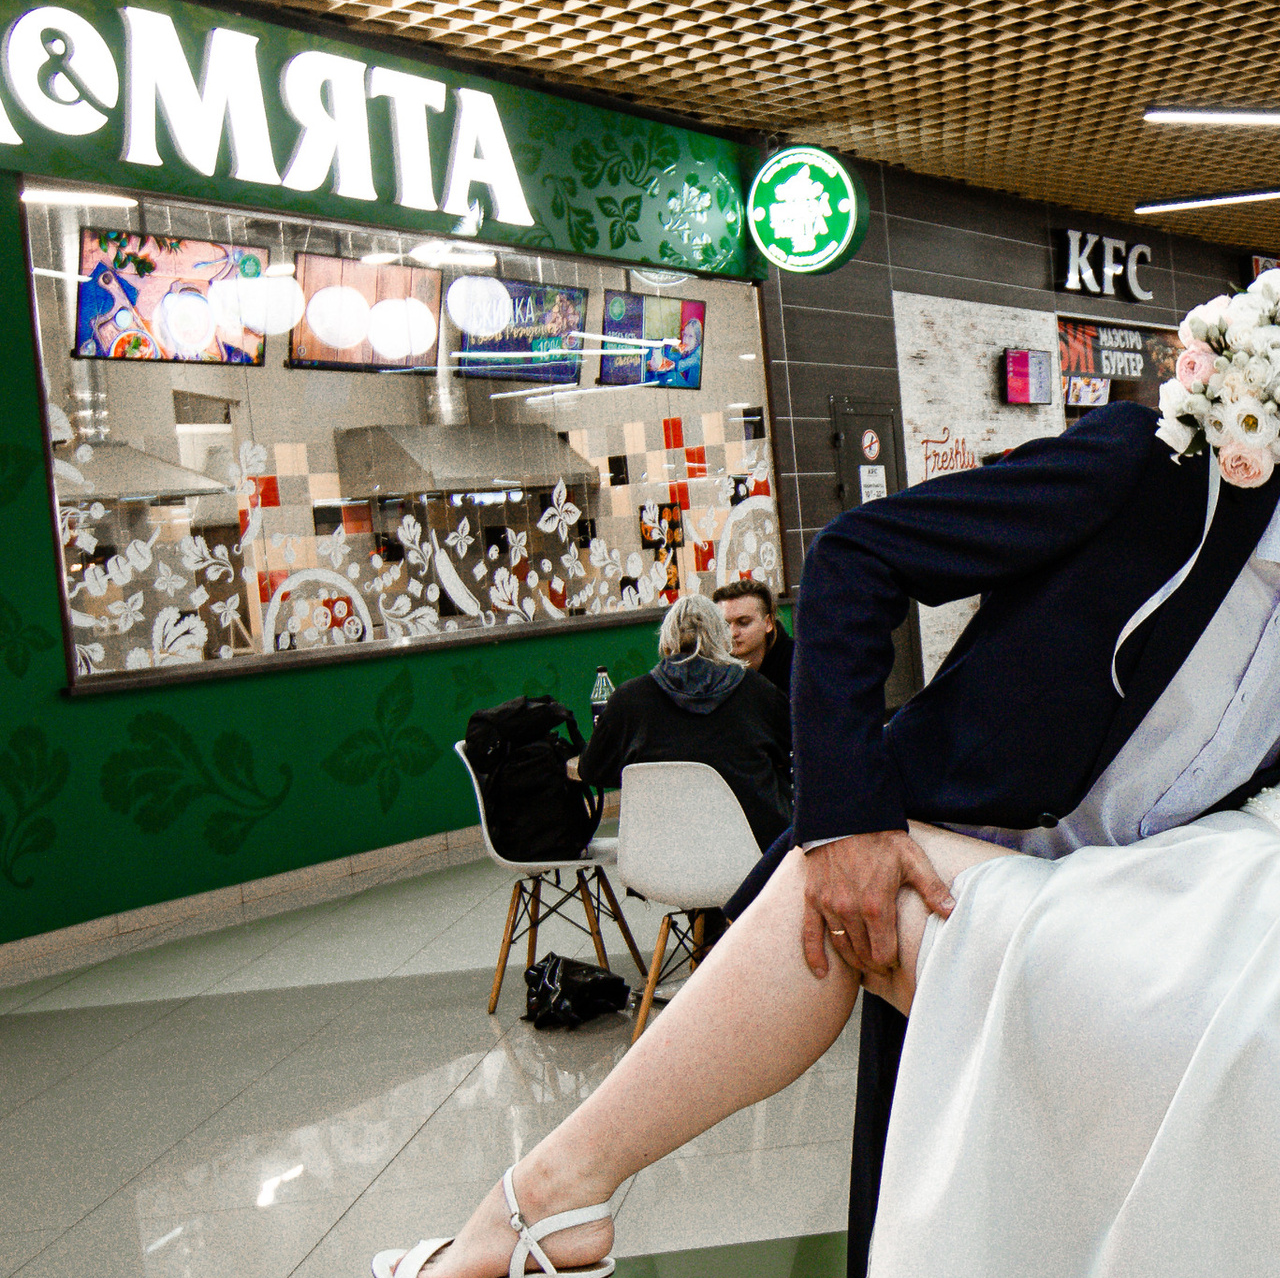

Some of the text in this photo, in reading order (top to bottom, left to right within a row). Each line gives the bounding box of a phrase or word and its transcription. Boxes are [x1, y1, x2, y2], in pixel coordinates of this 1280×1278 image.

[118, 6, 535, 227] МЯТА
[1066, 229, 1153, 301] KFC
[1100, 328, 1143, 350] МАЭСТРО
[1101, 349, 1145, 377] БУРГЕР
